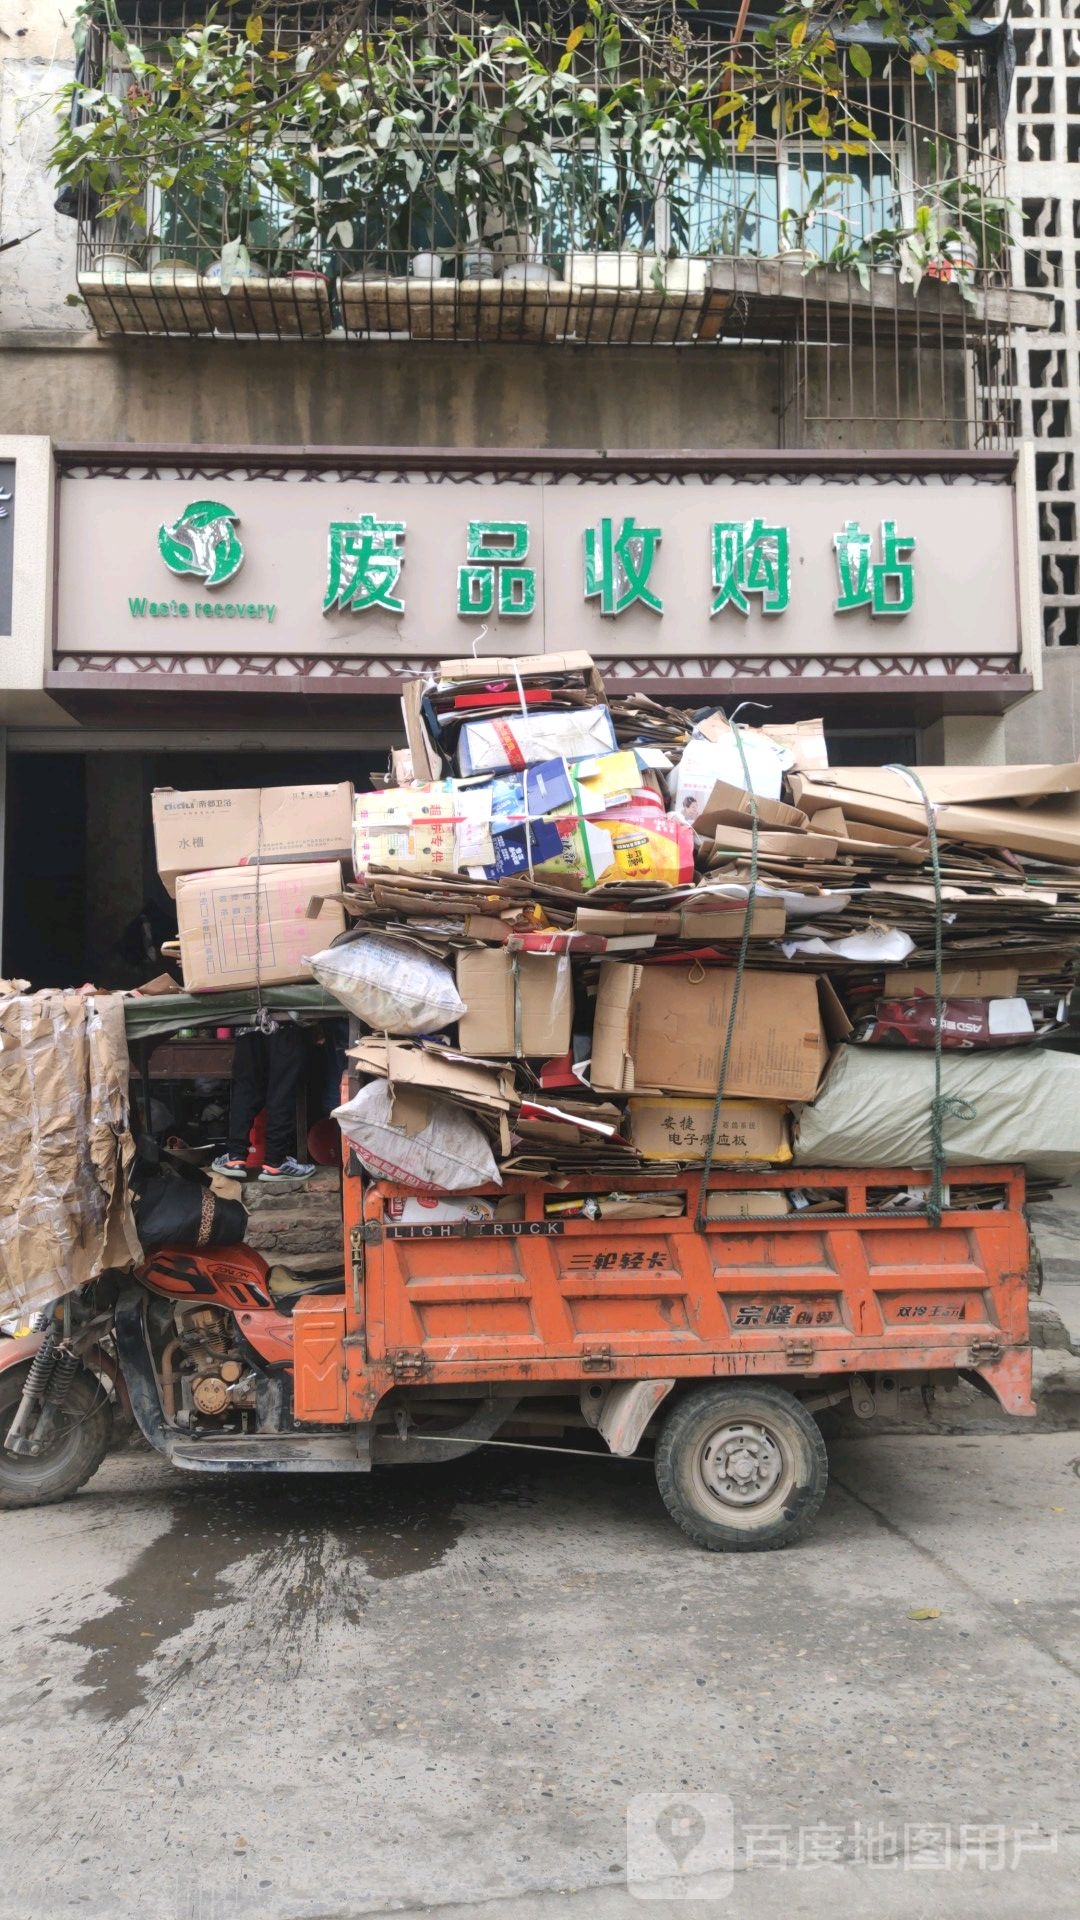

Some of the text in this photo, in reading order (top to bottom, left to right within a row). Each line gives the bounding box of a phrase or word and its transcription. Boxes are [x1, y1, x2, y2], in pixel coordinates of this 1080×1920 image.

[322, 511, 916, 617] 废品收购站
[128, 597, 277, 623] Waste recovery
[660, 1115, 696, 1131] 安捷
[394, 1226, 451, 1238] LIGH
[567, 1252, 668, 1271] 三轮轻卡
